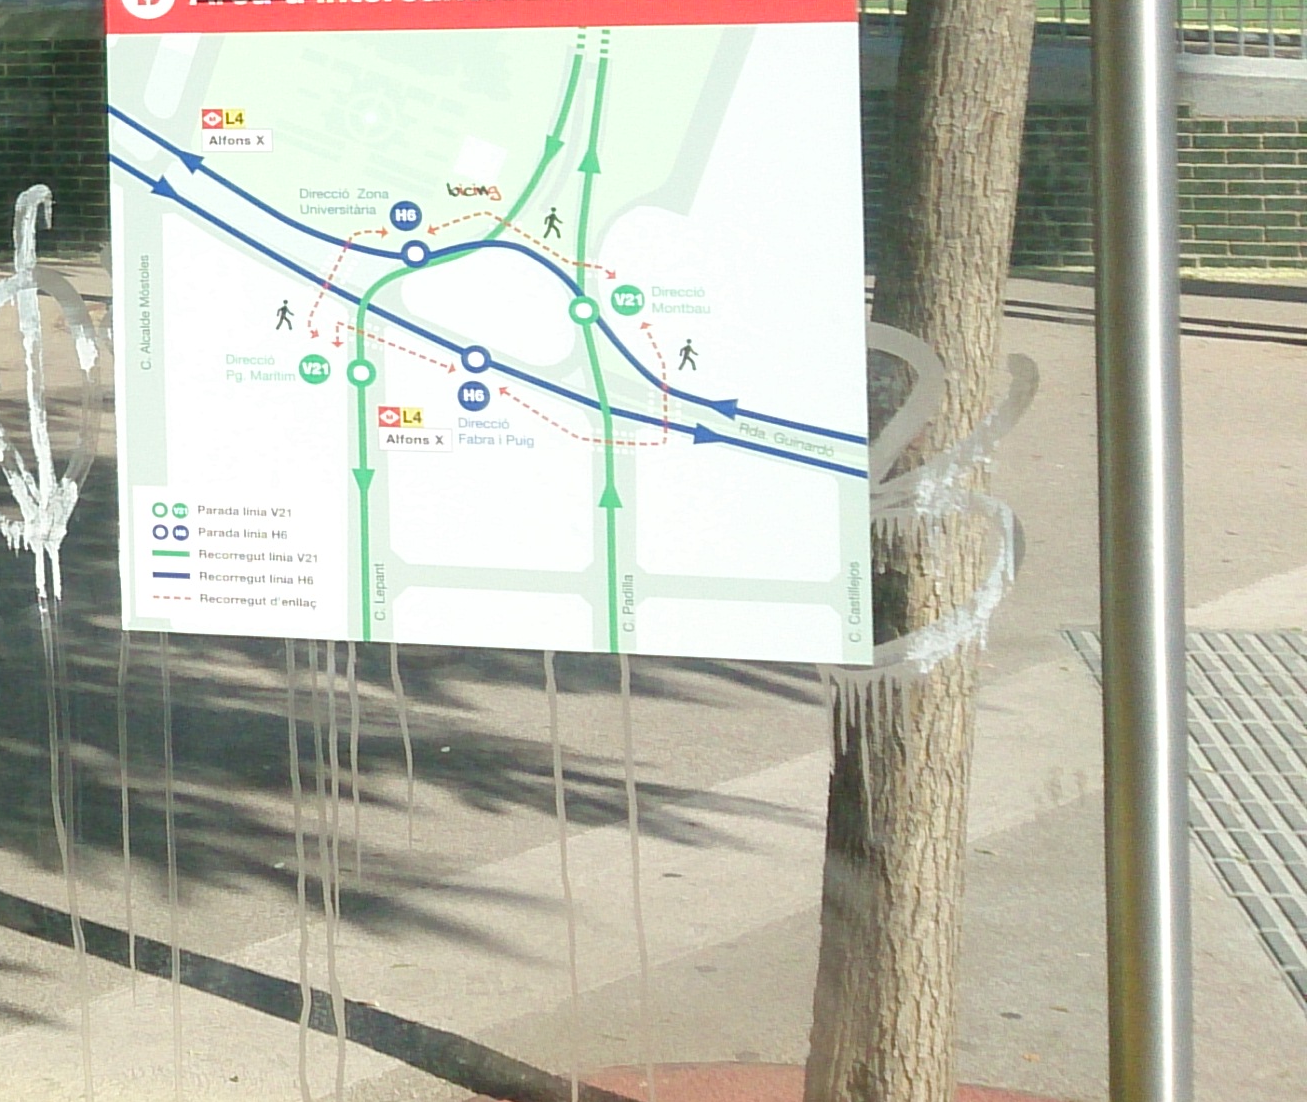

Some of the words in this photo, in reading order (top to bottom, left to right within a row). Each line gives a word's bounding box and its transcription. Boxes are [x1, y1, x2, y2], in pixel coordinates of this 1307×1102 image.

[225, 112, 245, 125] L4
[209, 135, 252, 146] Alfons
[256, 135, 265, 146] X
[299, 187, 350, 199] Direcció
[357, 188, 389, 199] Zona
[446, 182, 502, 201] bicing
[300, 203, 377, 215] Universitària
[395, 208, 417, 222] H6
[651, 285, 705, 298] Direcció
[614, 292, 643, 306] V21
[652, 302, 711, 314] Montbau
[140, 311, 152, 354] Alcalde
[226, 354, 275, 366] Direcció
[302, 361, 330, 375] V21
[226, 370, 247, 383] Pg.
[463, 388, 485, 403] H6
[402, 410, 422, 424] L4
[458, 417, 510, 430] Direcció
[386, 434, 430, 445] Alfons
[435, 435, 444, 445] X
[458, 433, 495, 445] Fabra
[506, 434, 535, 449] Puig
[739, 421, 767, 441] Rda.
[773, 430, 836, 458] Guinardó
[198, 504, 240, 516] Parada
[271, 507, 292, 518] V21
[198, 527, 240, 538] Parada
[271, 529, 288, 540] H6
[198, 549, 266, 563] Recorregut
[297, 553, 318, 563] V21
[199, 571, 266, 585] Recorregut
[297, 574, 314, 585] H6
[373, 562, 387, 605] Lepant
[622, 573, 635, 616] Padilla
[847, 561, 863, 625] Castillejos
[200, 594, 267, 607] Recorregut
